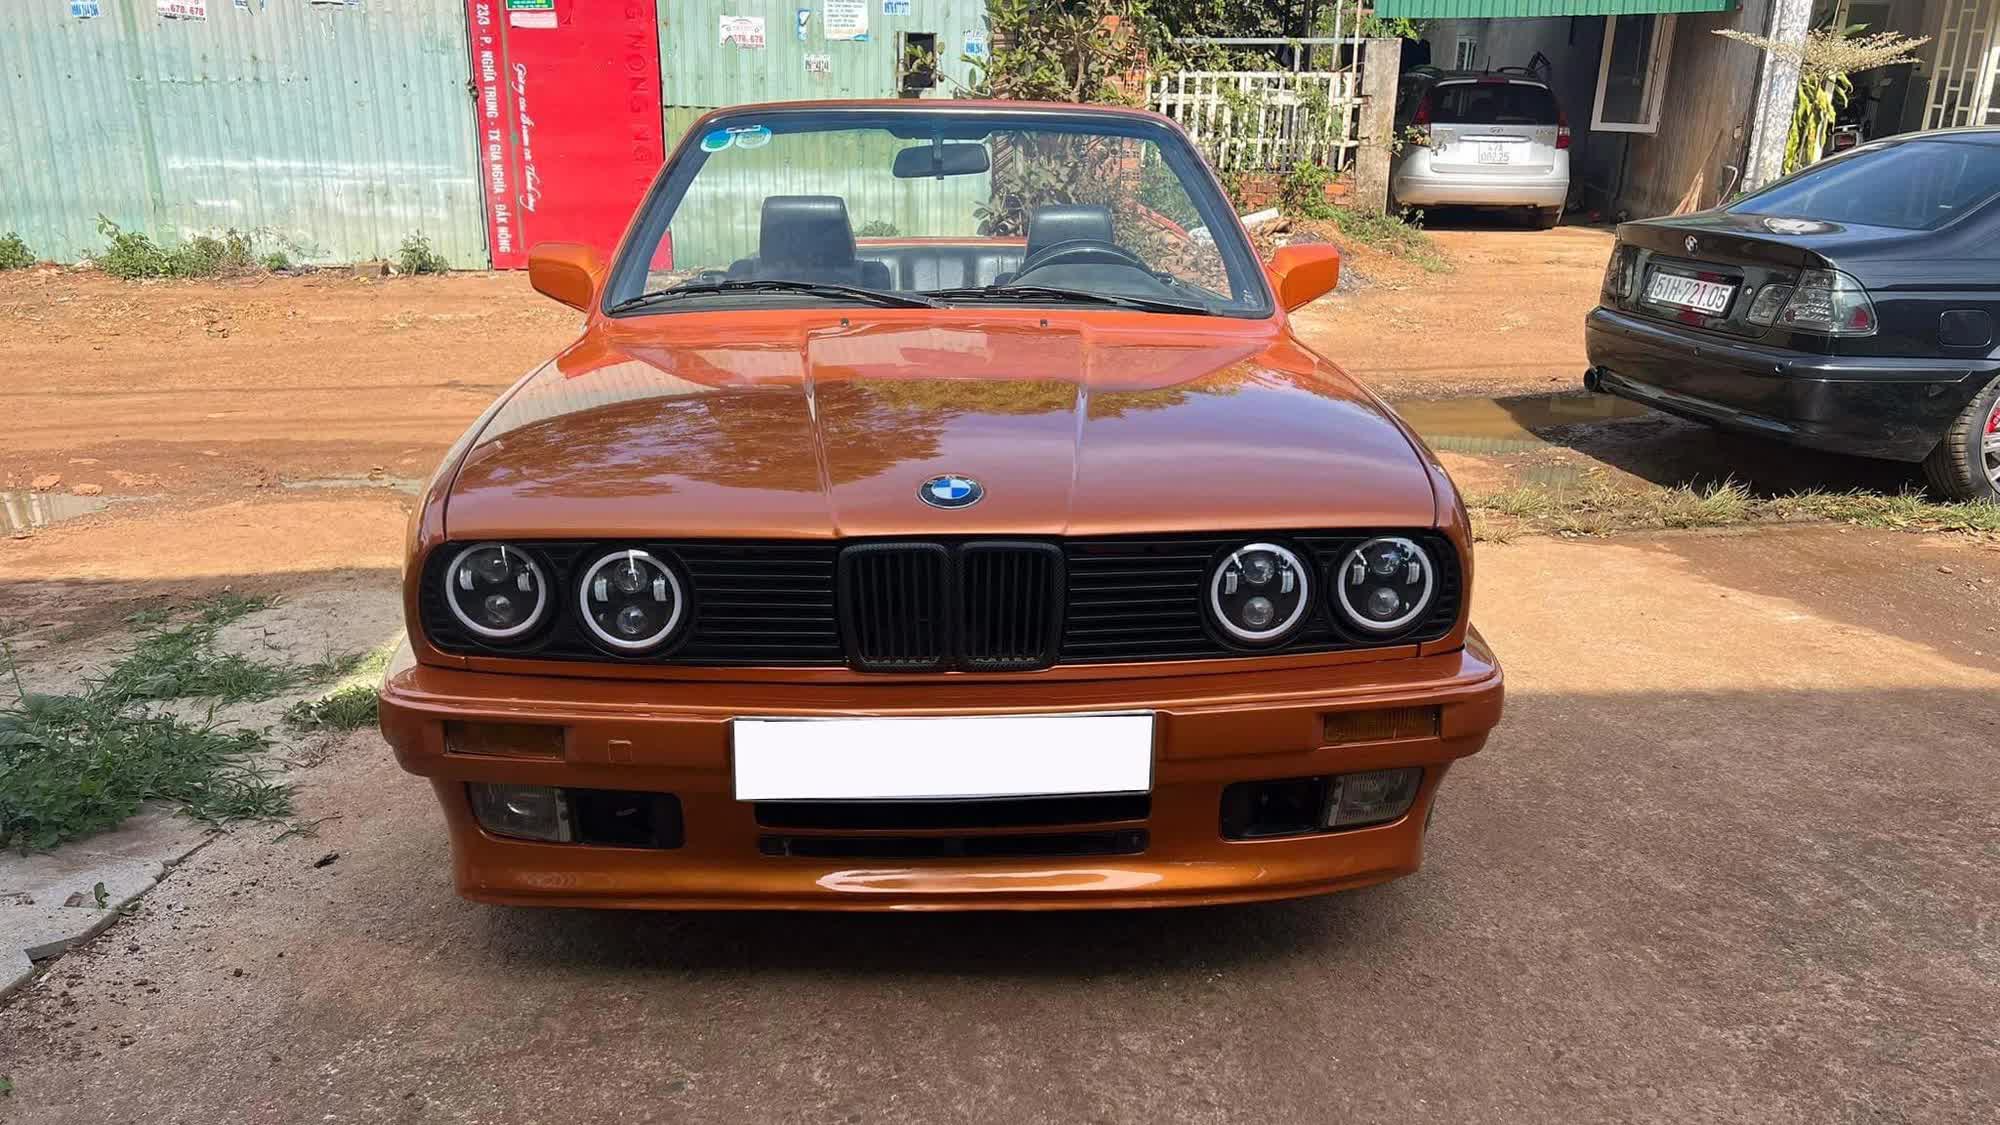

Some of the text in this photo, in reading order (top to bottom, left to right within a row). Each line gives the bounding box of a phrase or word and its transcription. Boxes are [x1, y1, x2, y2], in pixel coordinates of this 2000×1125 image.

[484, 86, 499, 119] TRUNG
[488, 129, 501, 141] TX
[490, 144, 503, 161] GIA
